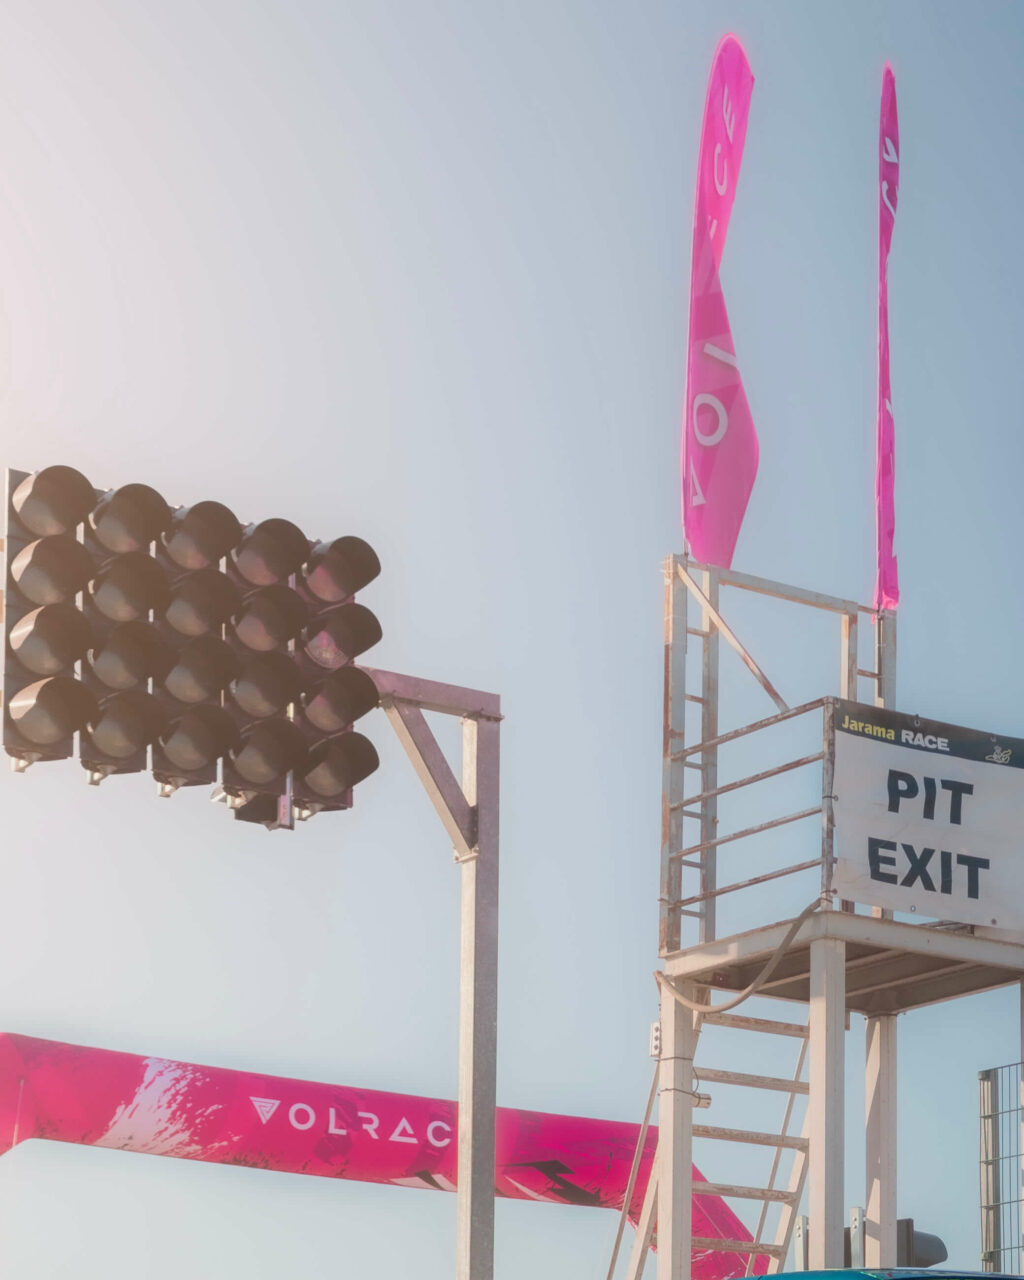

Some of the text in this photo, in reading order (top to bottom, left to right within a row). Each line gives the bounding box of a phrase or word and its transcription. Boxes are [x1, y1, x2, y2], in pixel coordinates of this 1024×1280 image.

[841, 715, 895, 741] Jarama
[901, 729, 950, 752] RACE
[887, 769, 974, 825] PIT
[868, 837, 990, 900] EXIT
[249, 1096, 452, 1148] VOLRAC
